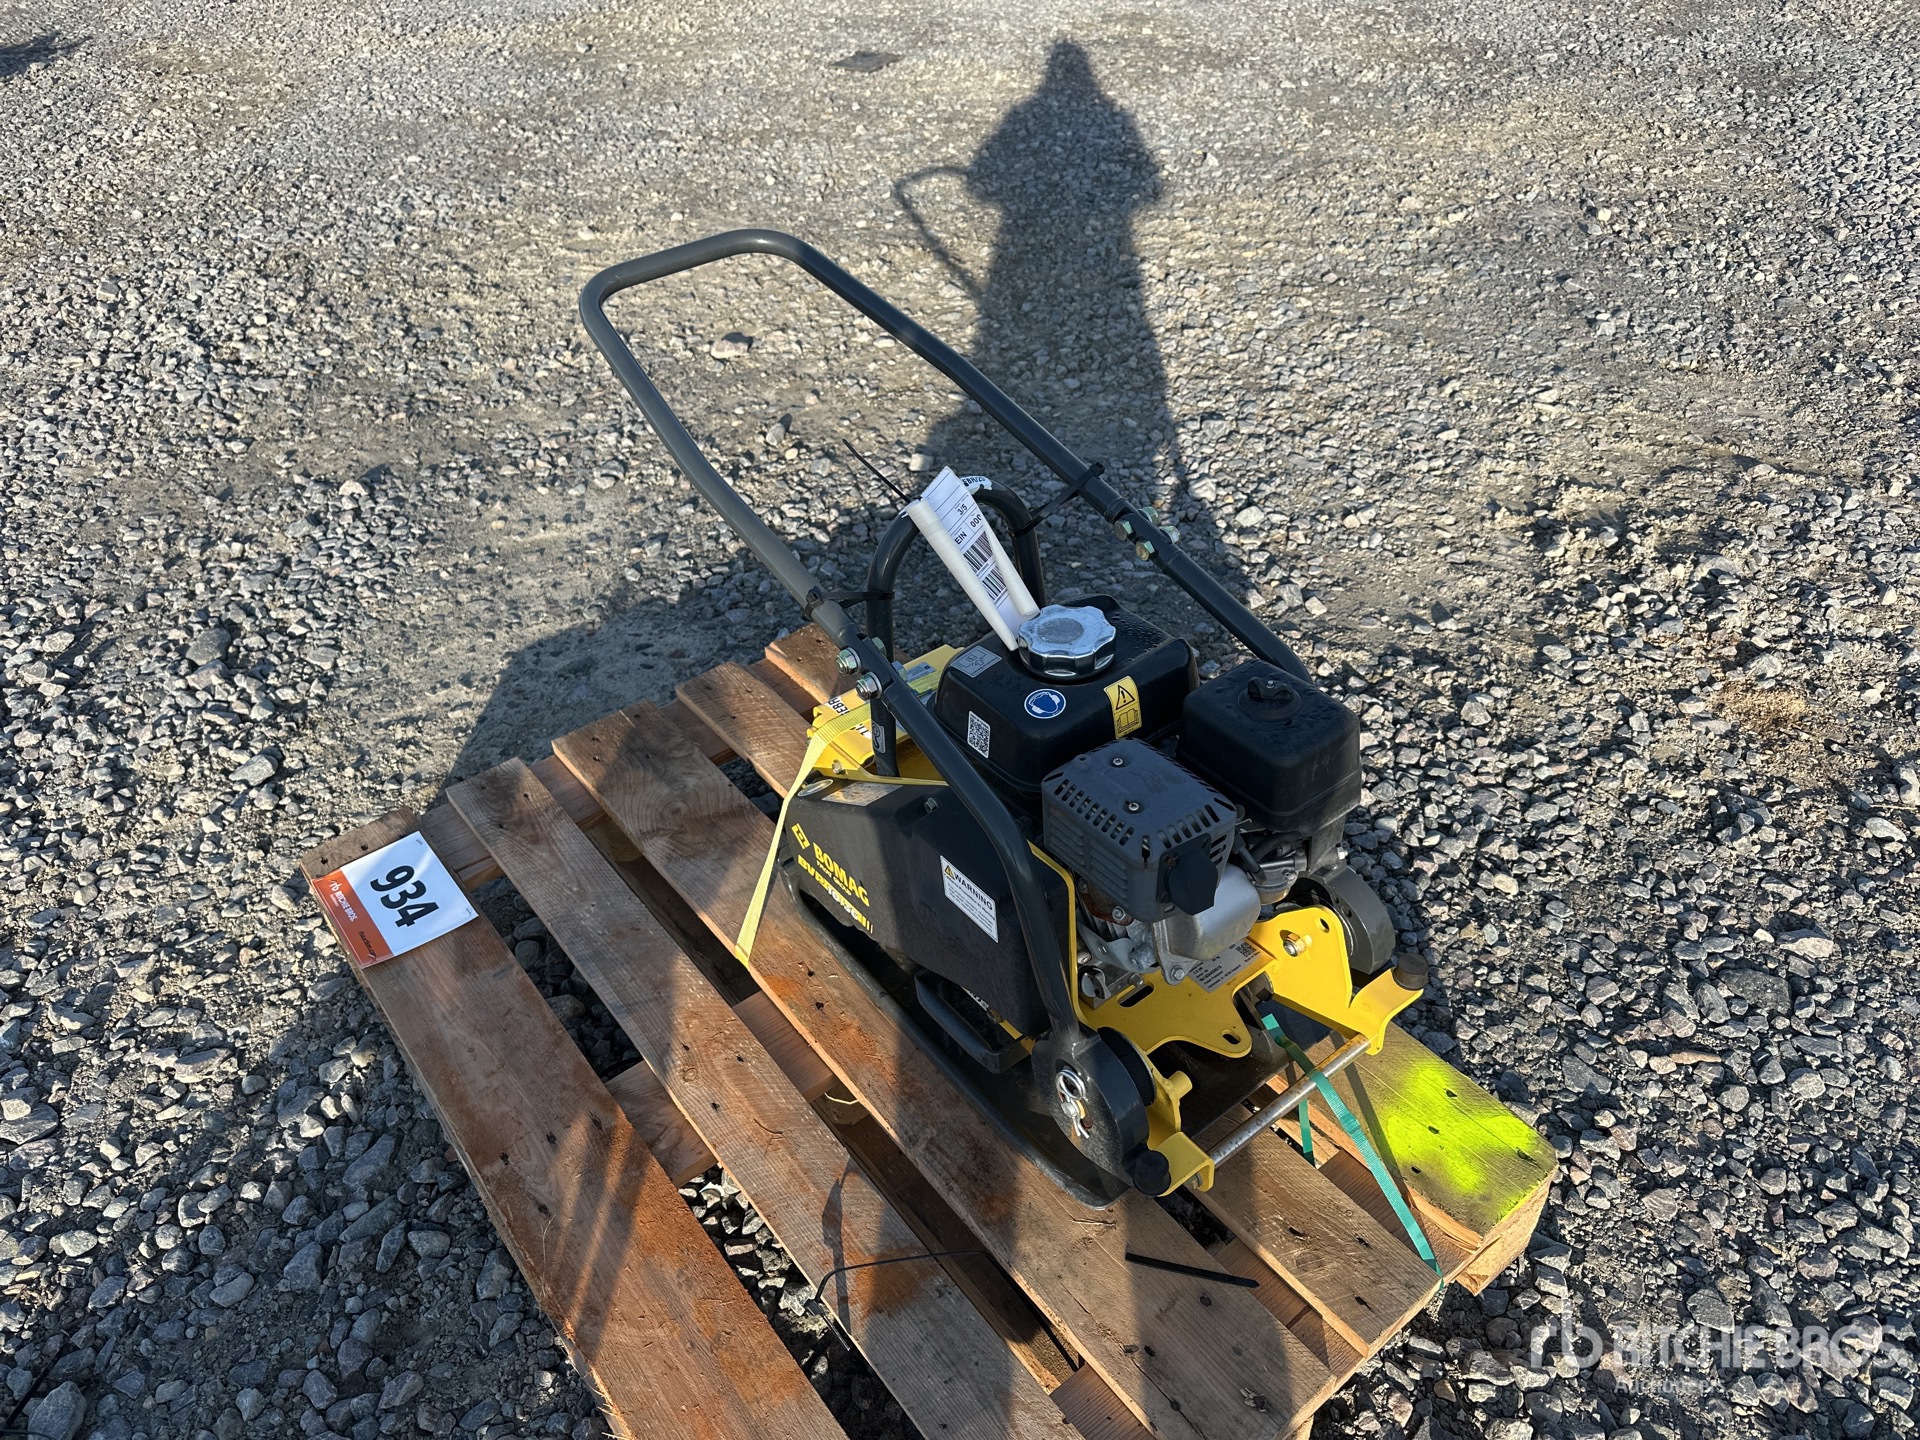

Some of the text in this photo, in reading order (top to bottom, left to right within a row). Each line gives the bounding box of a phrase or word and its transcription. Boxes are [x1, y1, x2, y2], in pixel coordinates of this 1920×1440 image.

[957, 504, 967, 515] 3/5
[954, 531, 967, 545] EIN
[813, 842, 870, 907] BOMAG
[954, 871, 993, 910] WARNING
[370, 865, 439, 928] 934
